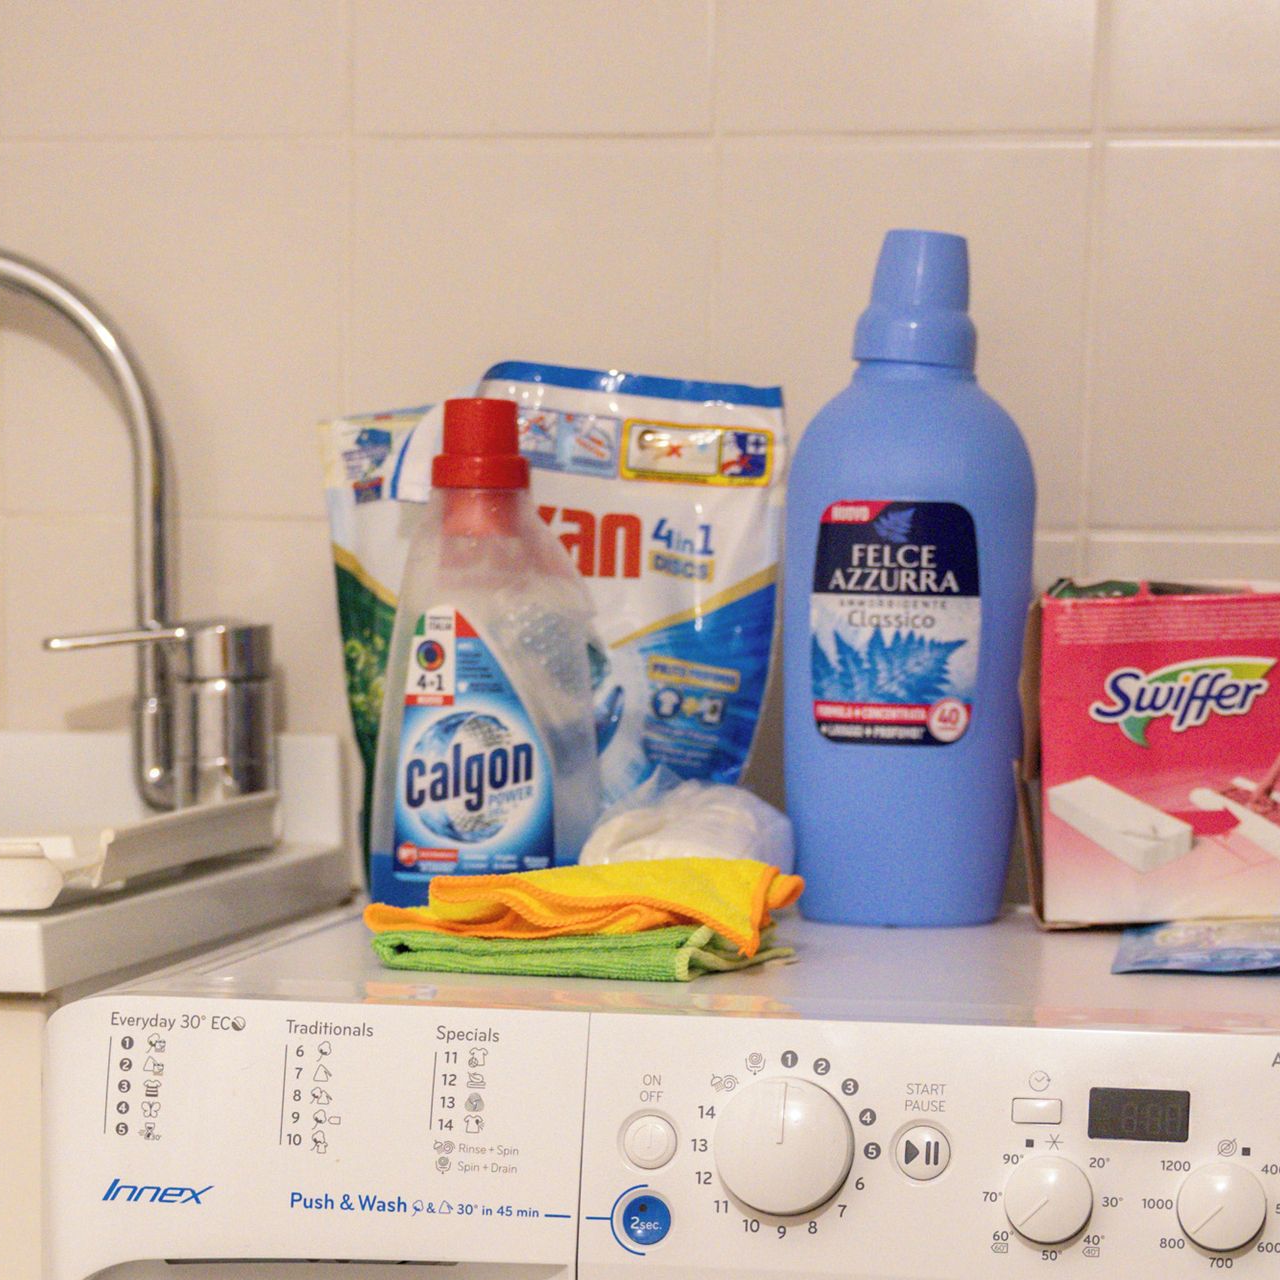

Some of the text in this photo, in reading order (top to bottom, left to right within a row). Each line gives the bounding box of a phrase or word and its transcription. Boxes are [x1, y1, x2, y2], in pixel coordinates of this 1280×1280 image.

[851, 544, 937, 568] FELCE
[828, 568, 960, 593] AZZURRA
[847, 610, 936, 629] Classico
[1094, 672, 1263, 727] Swiffer
[406, 743, 533, 812] Calgon
[110, 1011, 176, 1031] Everyday
[180, 1014, 206, 1029] 30°
[286, 1019, 374, 1037] Traditionals
[436, 1025, 500, 1043] Specials
[295, 1045, 304, 1057] 6
[444, 1051, 458, 1064] 11
[295, 1067, 303, 1079] 7
[441, 1073, 457, 1086] 12
[642, 1074, 661, 1086] ON
[292, 1089, 301, 1101] 8
[906, 1083, 947, 1095] START
[440, 1096, 455, 1109] 13
[639, 1090, 664, 1102] OFF
[698, 1105, 716, 1119] 14
[904, 1099, 946, 1112] PAUSE
[291, 1111, 300, 1124] 9
[438, 1118, 454, 1131] 14
[286, 1133, 302, 1146] 10
[691, 1138, 708, 1152] 13
[458, 1143, 487, 1154] Rinse
[497, 1145, 519, 1157] Spin
[1002, 1153, 1024, 1165] 90°
[1089, 1157, 1110, 1168] 20°
[457, 1161, 480, 1173] Spin
[491, 1163, 517, 1174] Drain
[1160, 1160, 1191, 1172] 1200
[695, 1171, 712, 1185] 12
[855, 1177, 865, 1191] 6
[101, 1178, 214, 1205] Innex
[982, 1191, 1003, 1202] 70°
[290, 1191, 539, 1218] Push & Wash & 30° in 45 min
[713, 1200, 728, 1213] 11
[1102, 1196, 1124, 1208] 30°
[1142, 1198, 1174, 1210] 1000
[838, 1205, 847, 1218] 7
[630, 1216, 663, 1230] 2sec.
[742, 1219, 760, 1233] 10
[808, 1221, 818, 1235] 8
[777, 1225, 786, 1239] 9
[992, 1230, 1014, 1242] 60°
[1083, 1234, 1105, 1245] 40°
[1159, 1238, 1186, 1250] 800
[1041, 1250, 1063, 1261] 50°
[1209, 1257, 1233, 1269] 700
